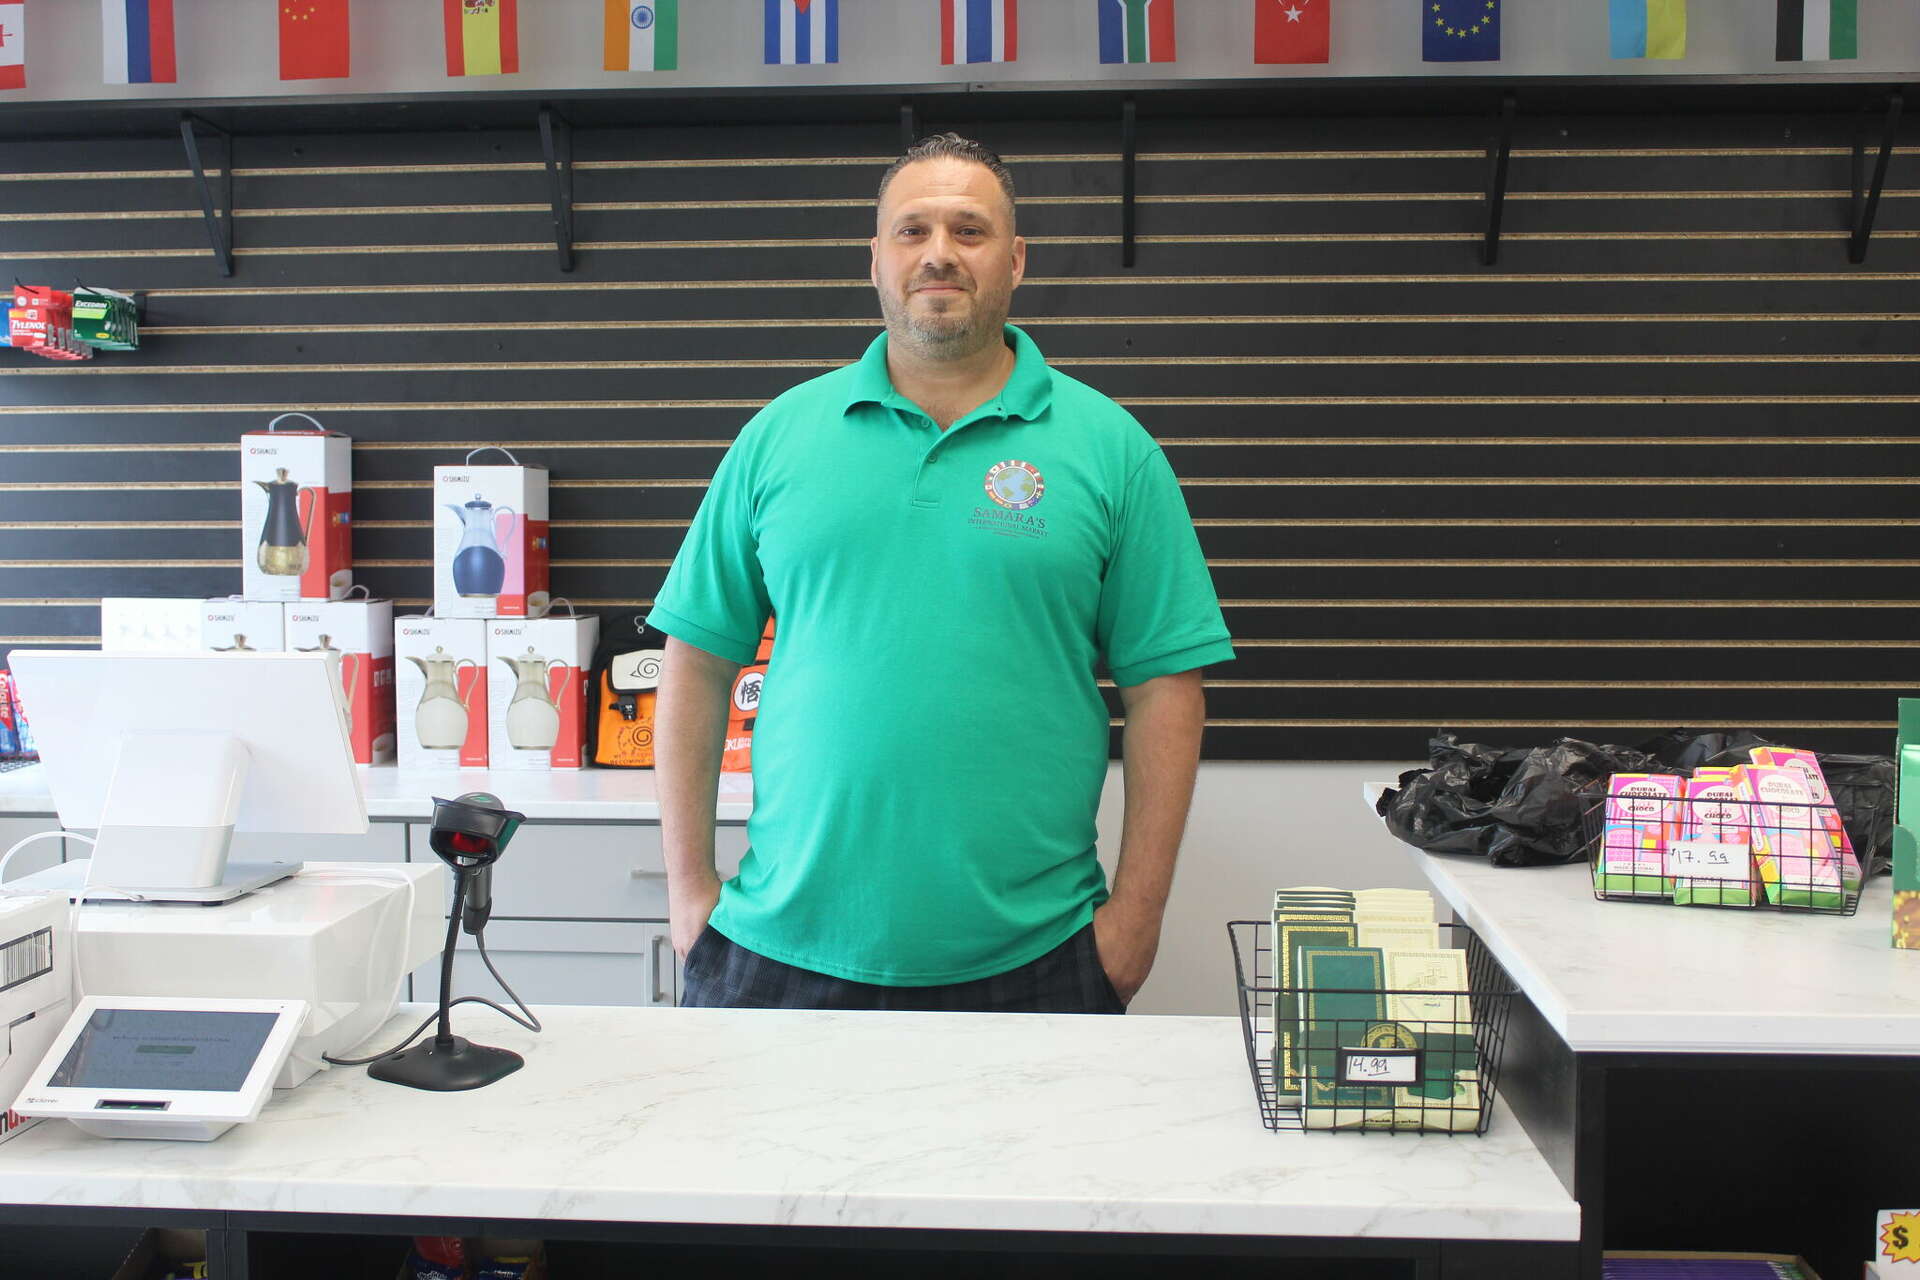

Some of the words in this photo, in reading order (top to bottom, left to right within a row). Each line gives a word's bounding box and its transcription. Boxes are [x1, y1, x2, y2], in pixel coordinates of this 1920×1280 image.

[12, 320, 46, 329] TYLENOL
[974, 507, 1045, 528] SAMARA'S
[1348, 1056, 1388, 1075] 14.99
